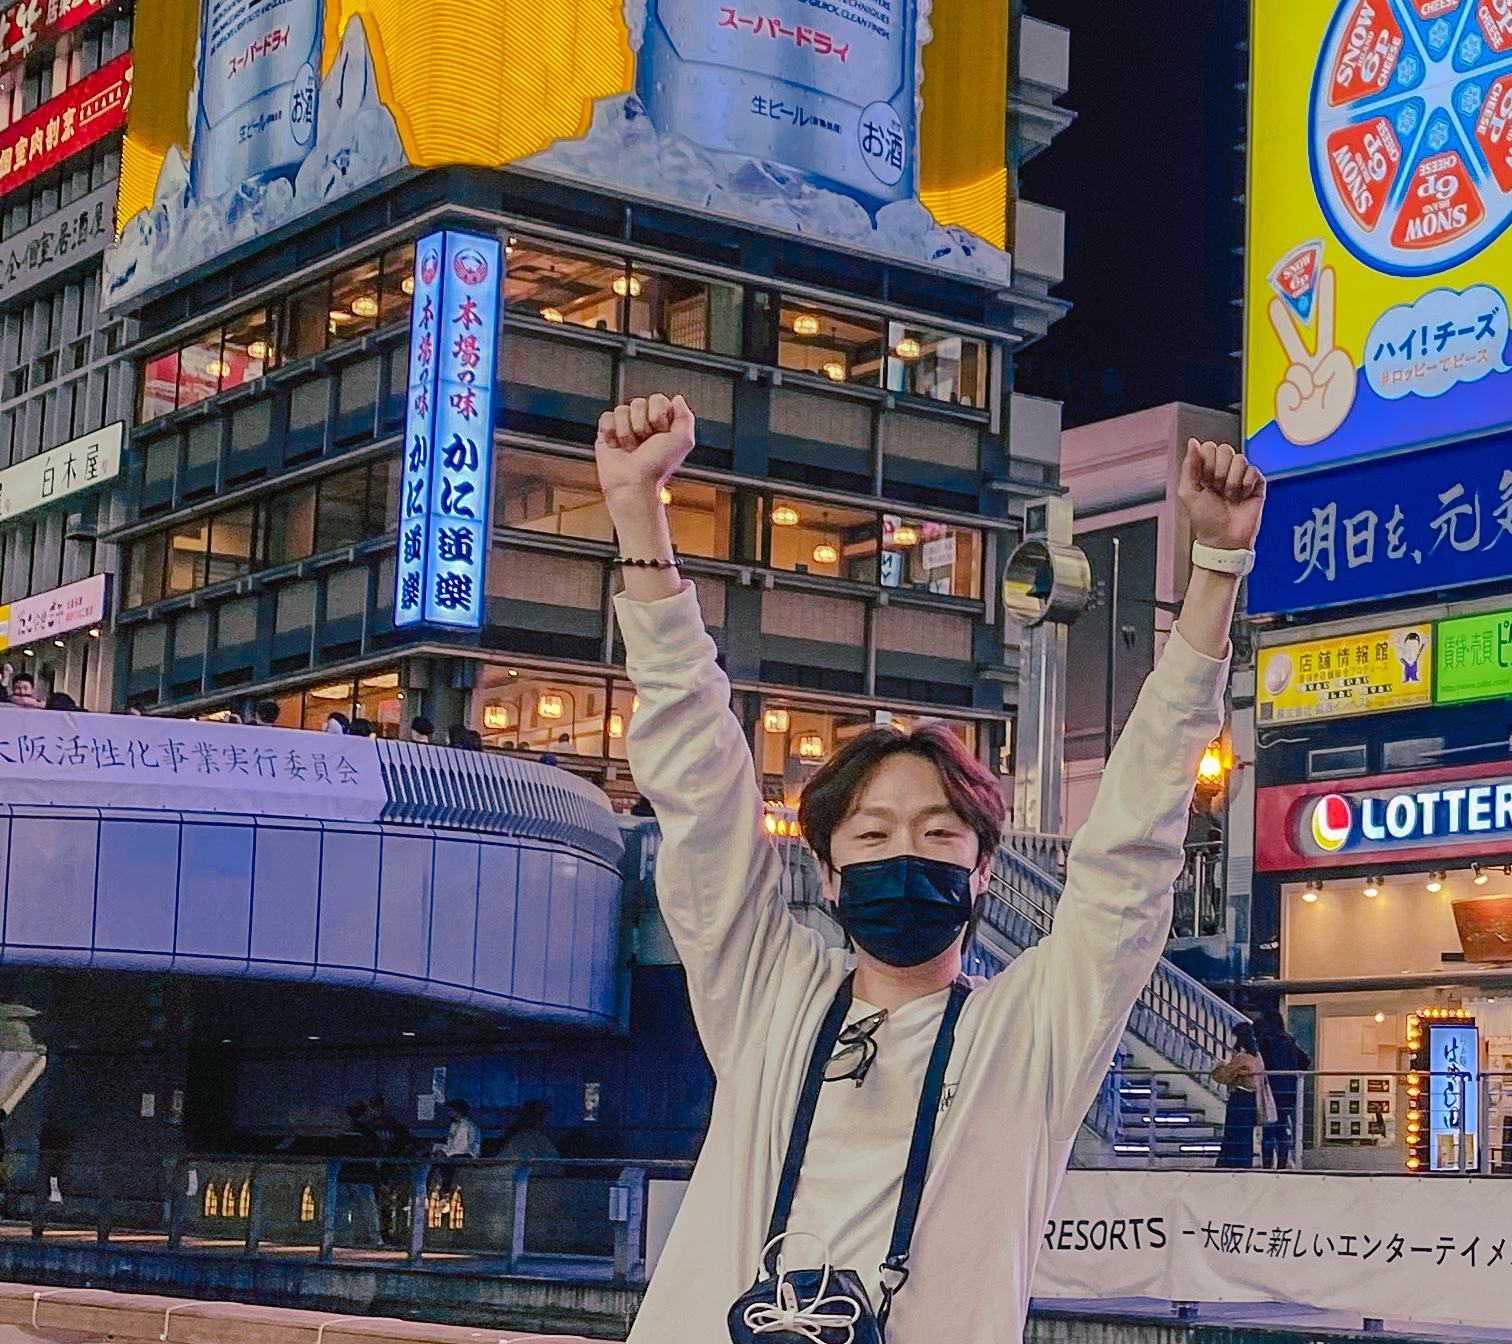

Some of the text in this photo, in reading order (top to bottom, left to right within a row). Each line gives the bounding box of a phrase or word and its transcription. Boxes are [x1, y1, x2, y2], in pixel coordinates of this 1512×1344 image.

[718, 6, 849, 63] スーパードライ
[1337, 0, 1376, 87] SNOW
[1360, 29, 1390, 83] 6P
[862, 121, 903, 170] お酒
[1332, 144, 1373, 214] SNOW
[1417, 175, 1459, 200] 6P
[1404, 204, 1467, 242] SNOW
[450, 295, 483, 422] 本場の味
[42, 443, 100, 499] 白木屋
[1040, 1217, 1167, 1251] RESORTS
